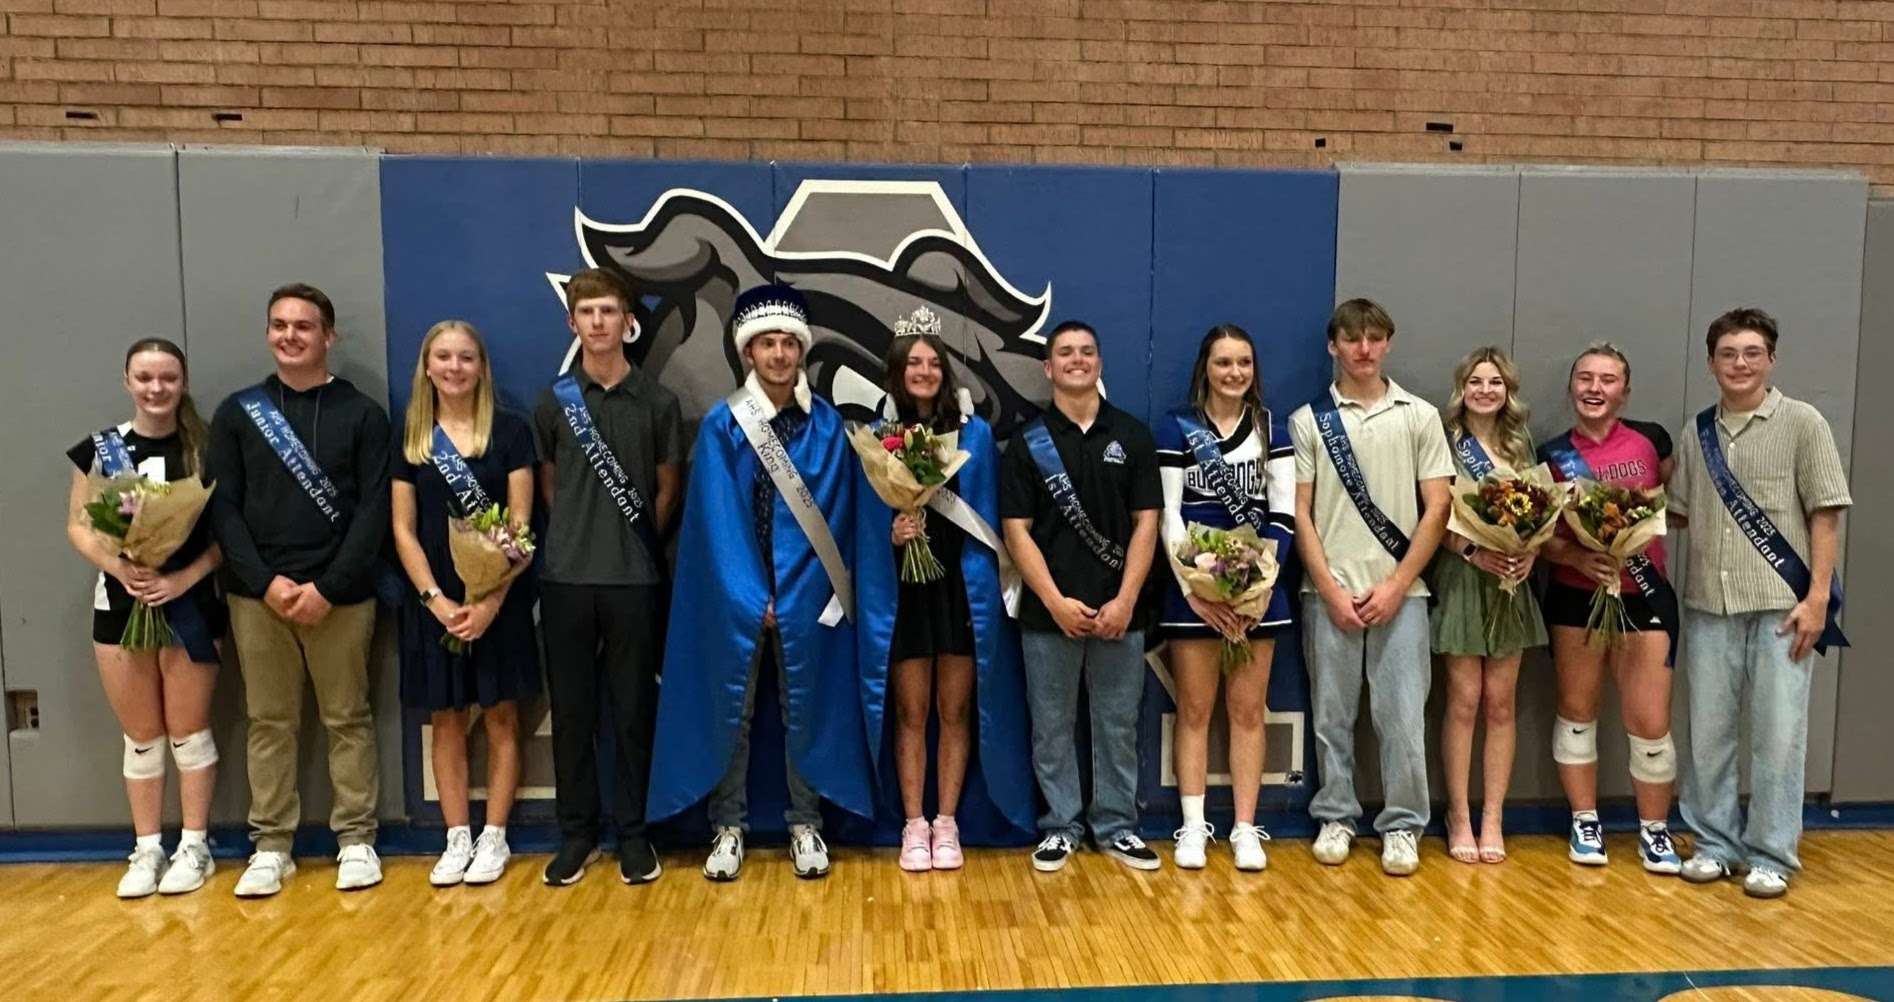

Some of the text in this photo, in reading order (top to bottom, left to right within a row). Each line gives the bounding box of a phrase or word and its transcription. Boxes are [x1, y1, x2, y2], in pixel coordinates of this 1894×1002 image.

[246, 401, 340, 523] Junior Attendant
[564, 403, 640, 522] 2nd Attendant
[590, 426, 628, 484] HOMECOMING
[758, 441, 780, 474] King
[759, 418, 798, 480] HOMECOMING
[1319, 412, 1353, 486] Sophomore
[1459, 440, 1485, 480] Sopho
[1200, 459, 1246, 524] Attenda
[1729, 500, 1784, 568] Attendant
[1756, 516, 1776, 537] 2025
[1625, 558, 1655, 597] ndant
